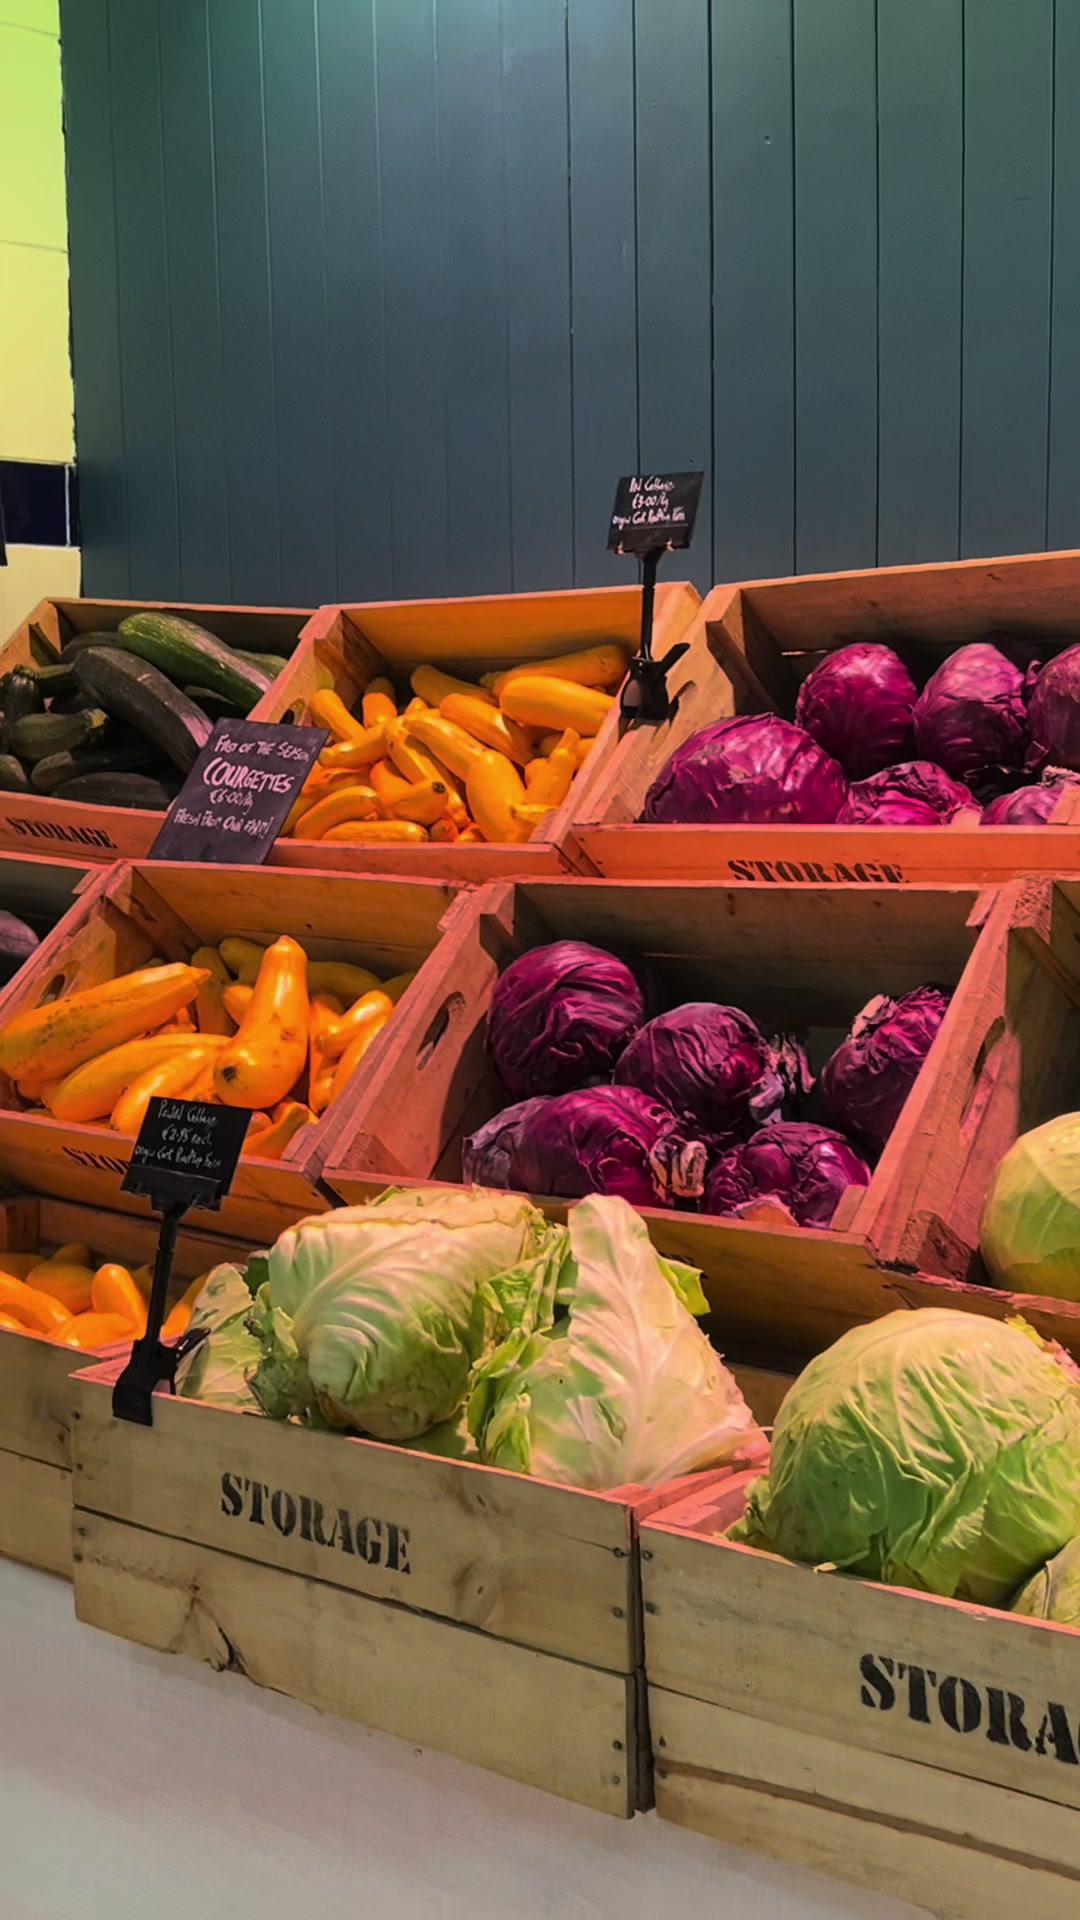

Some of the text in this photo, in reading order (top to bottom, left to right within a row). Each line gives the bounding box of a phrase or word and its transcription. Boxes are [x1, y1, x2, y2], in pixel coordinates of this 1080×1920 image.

[256, 741, 276, 755] THE
[203, 757, 295, 793] COURGETTES
[5, 817, 119, 849] STORAGE
[727, 859, 909, 883] STORAGE
[221, 1472, 411, 1575] STORAGE
[859, 1653, 1080, 1765] STORA
